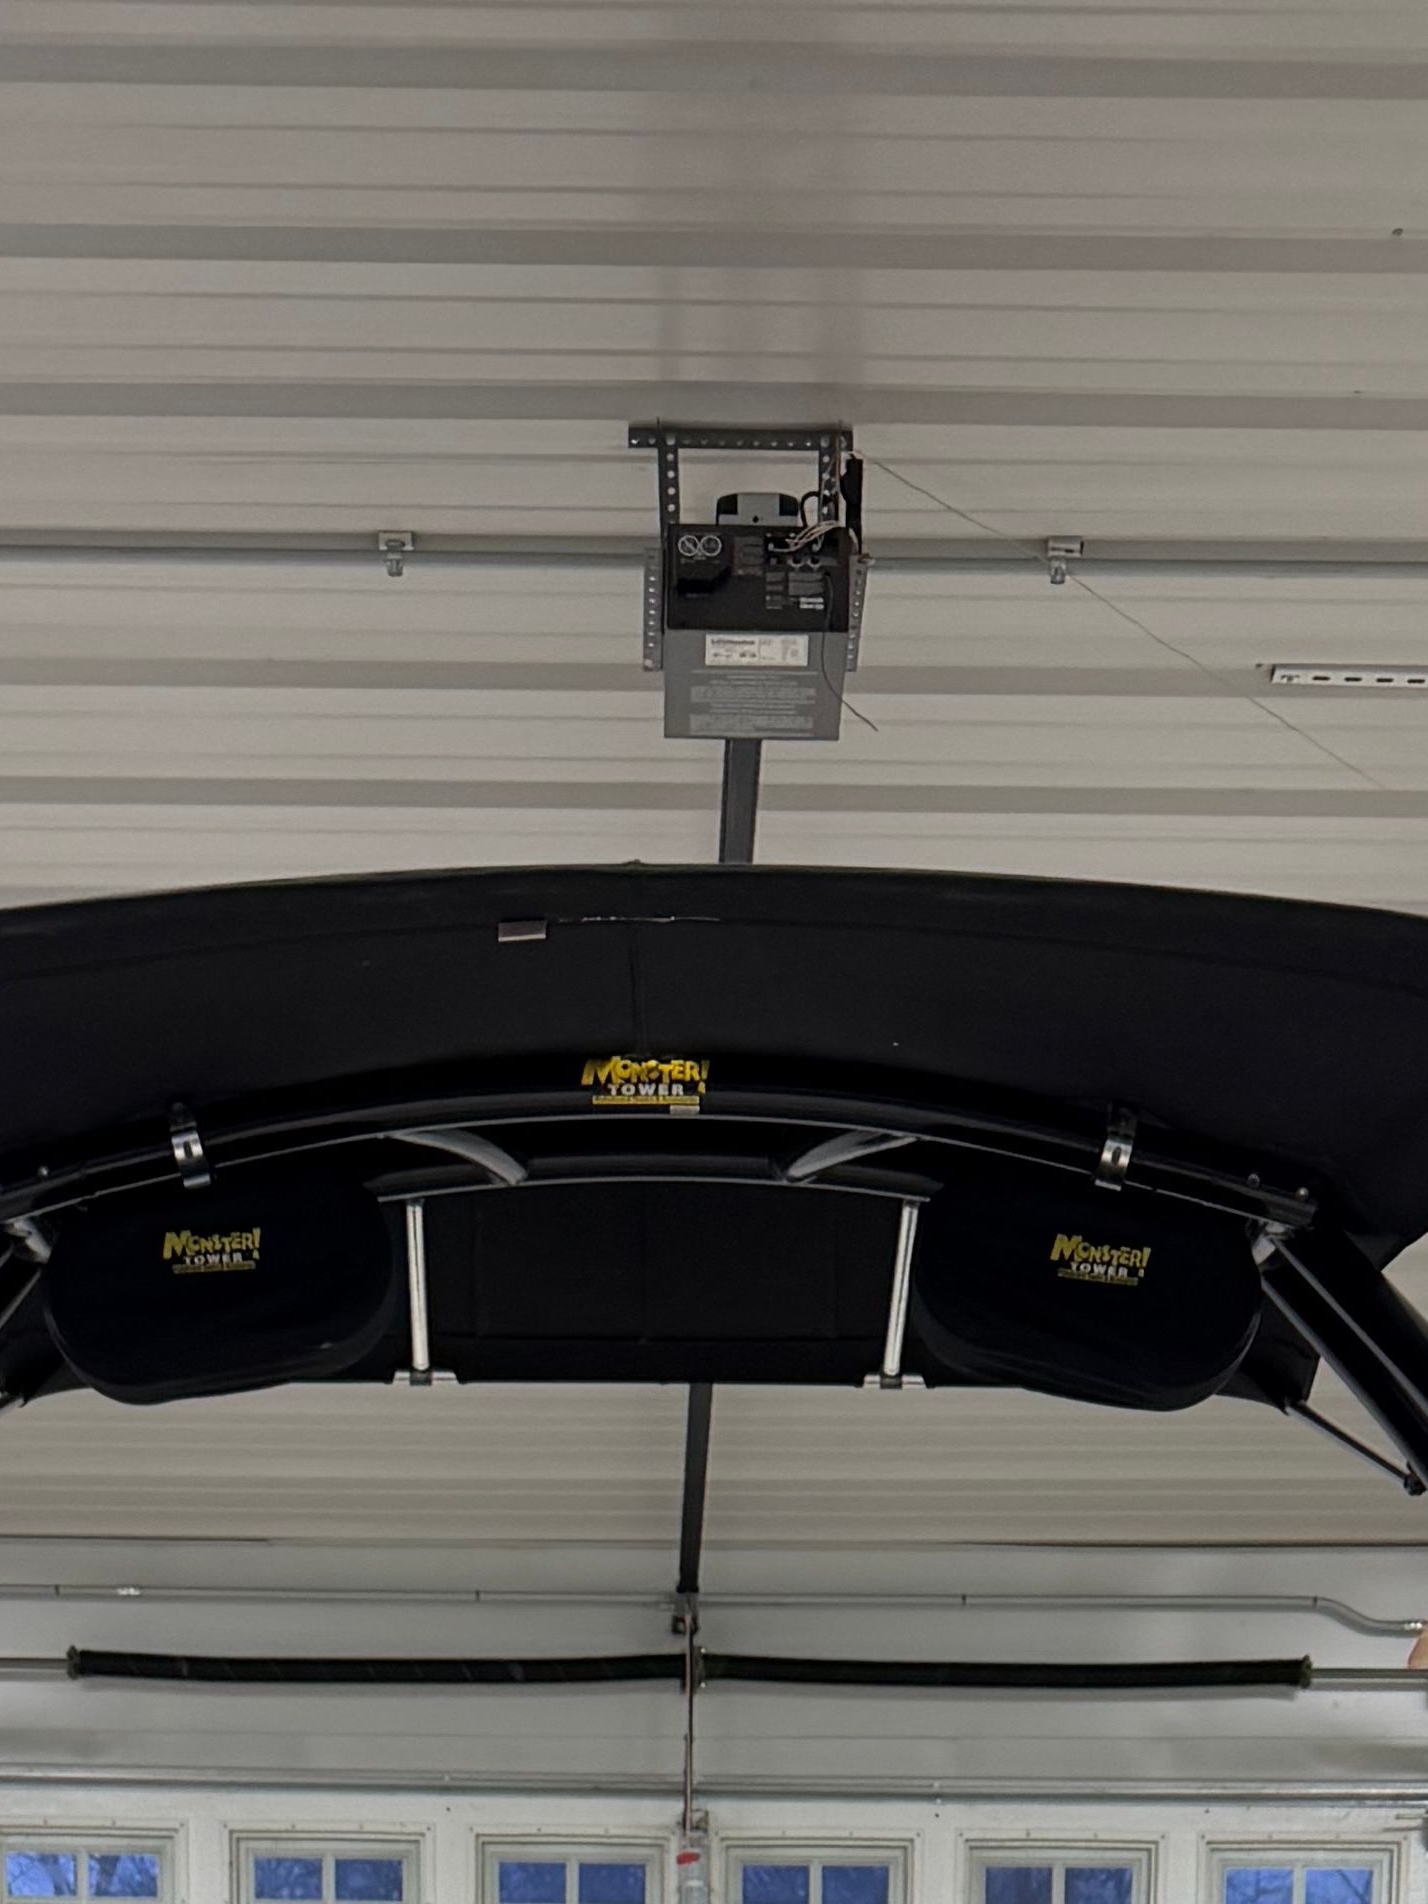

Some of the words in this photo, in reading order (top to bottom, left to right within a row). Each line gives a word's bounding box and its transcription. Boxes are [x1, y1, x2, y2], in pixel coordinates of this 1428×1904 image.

[581, 1056, 710, 1094] MONSTER!
[608, 1083, 685, 1095] TOWER
[162, 1227, 261, 1260] MONSTER!
[1050, 1233, 1152, 1278] MONSTER!
[183, 1252, 244, 1266] TOWER
[1070, 1262, 1129, 1278] TOWER
